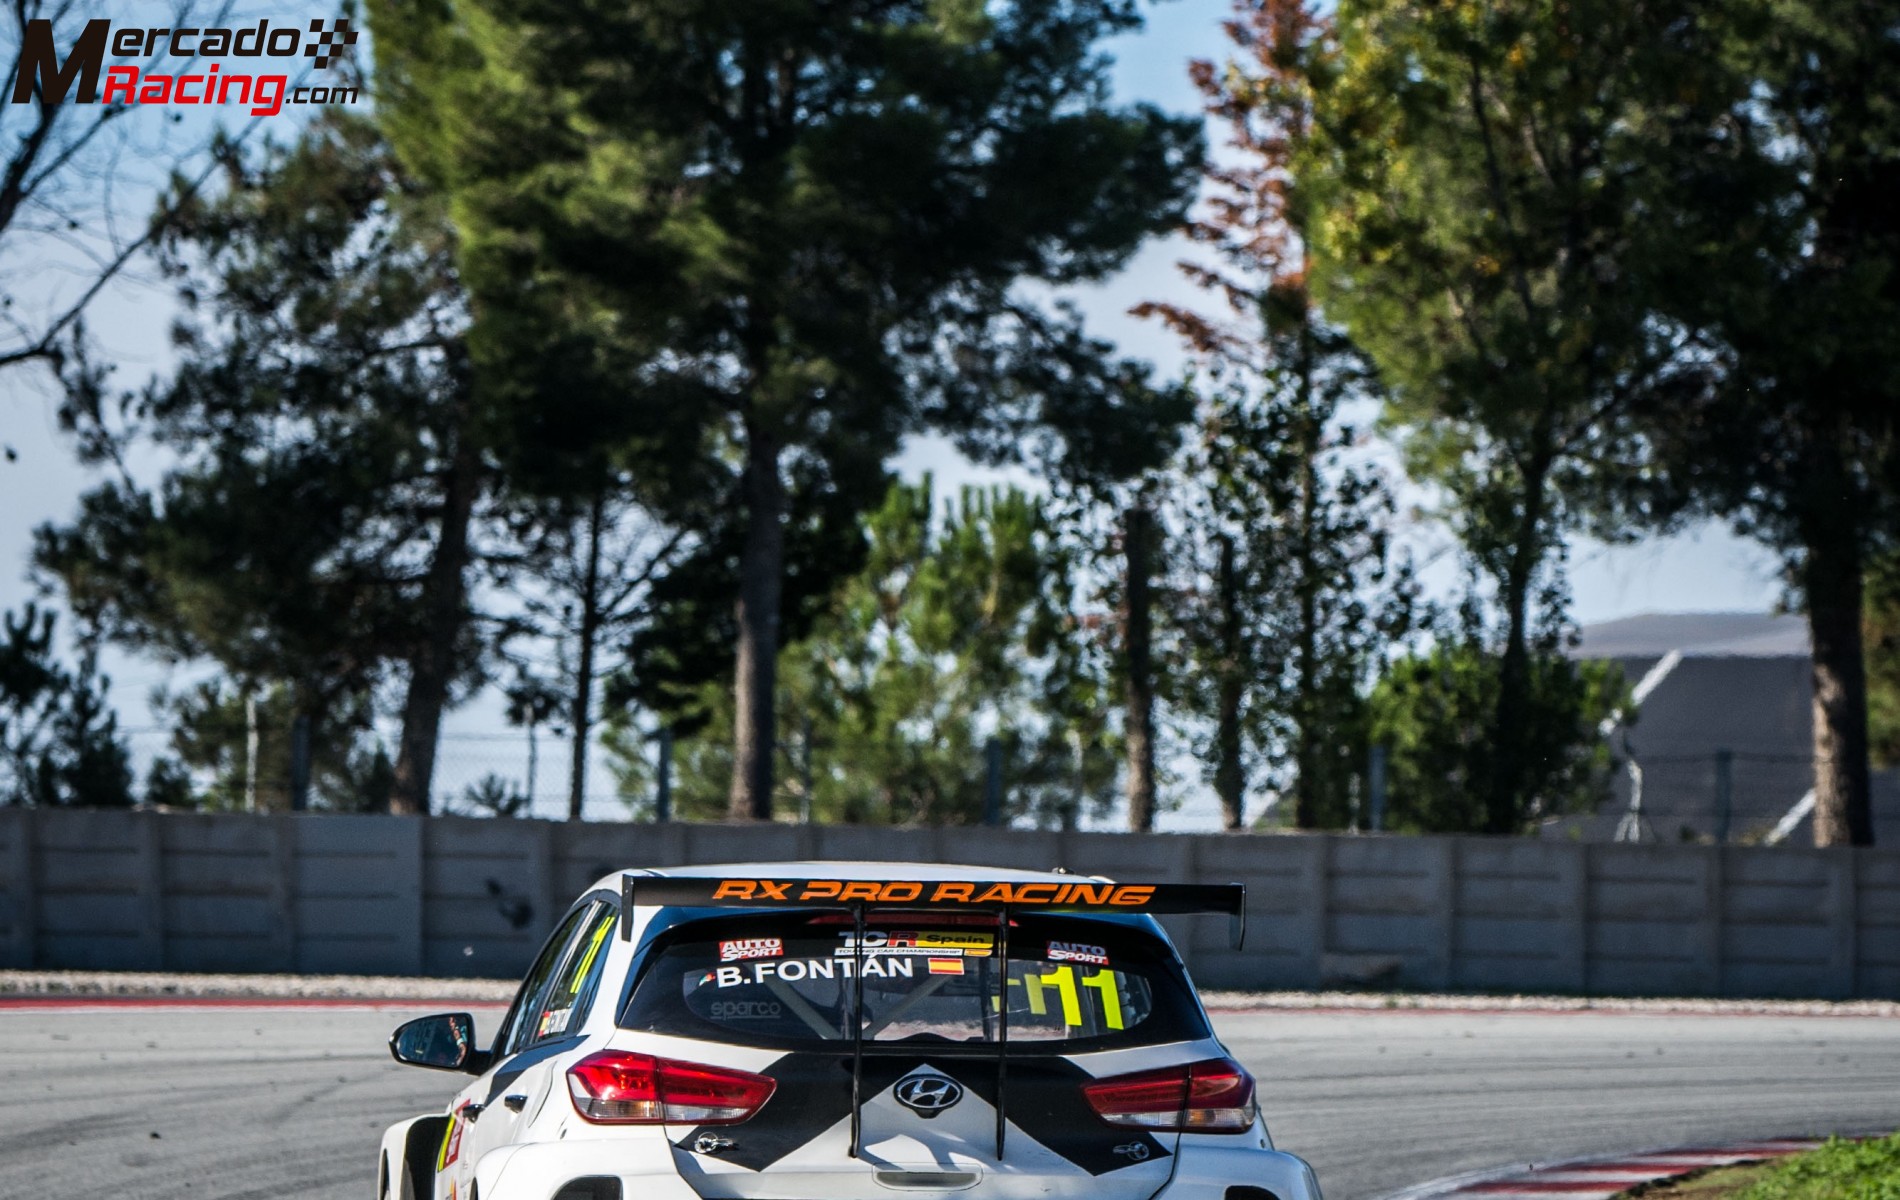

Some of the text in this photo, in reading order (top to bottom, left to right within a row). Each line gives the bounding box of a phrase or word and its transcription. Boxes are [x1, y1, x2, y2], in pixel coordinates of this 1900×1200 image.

[712, 880, 1156, 905] RX PRO RACING
[721, 938, 781, 950] AUTO
[926, 934, 984, 944] Spain
[1049, 941, 1106, 955] AUTO
[1041, 966, 1124, 1030] 11
[710, 1001, 781, 1020] sparco
